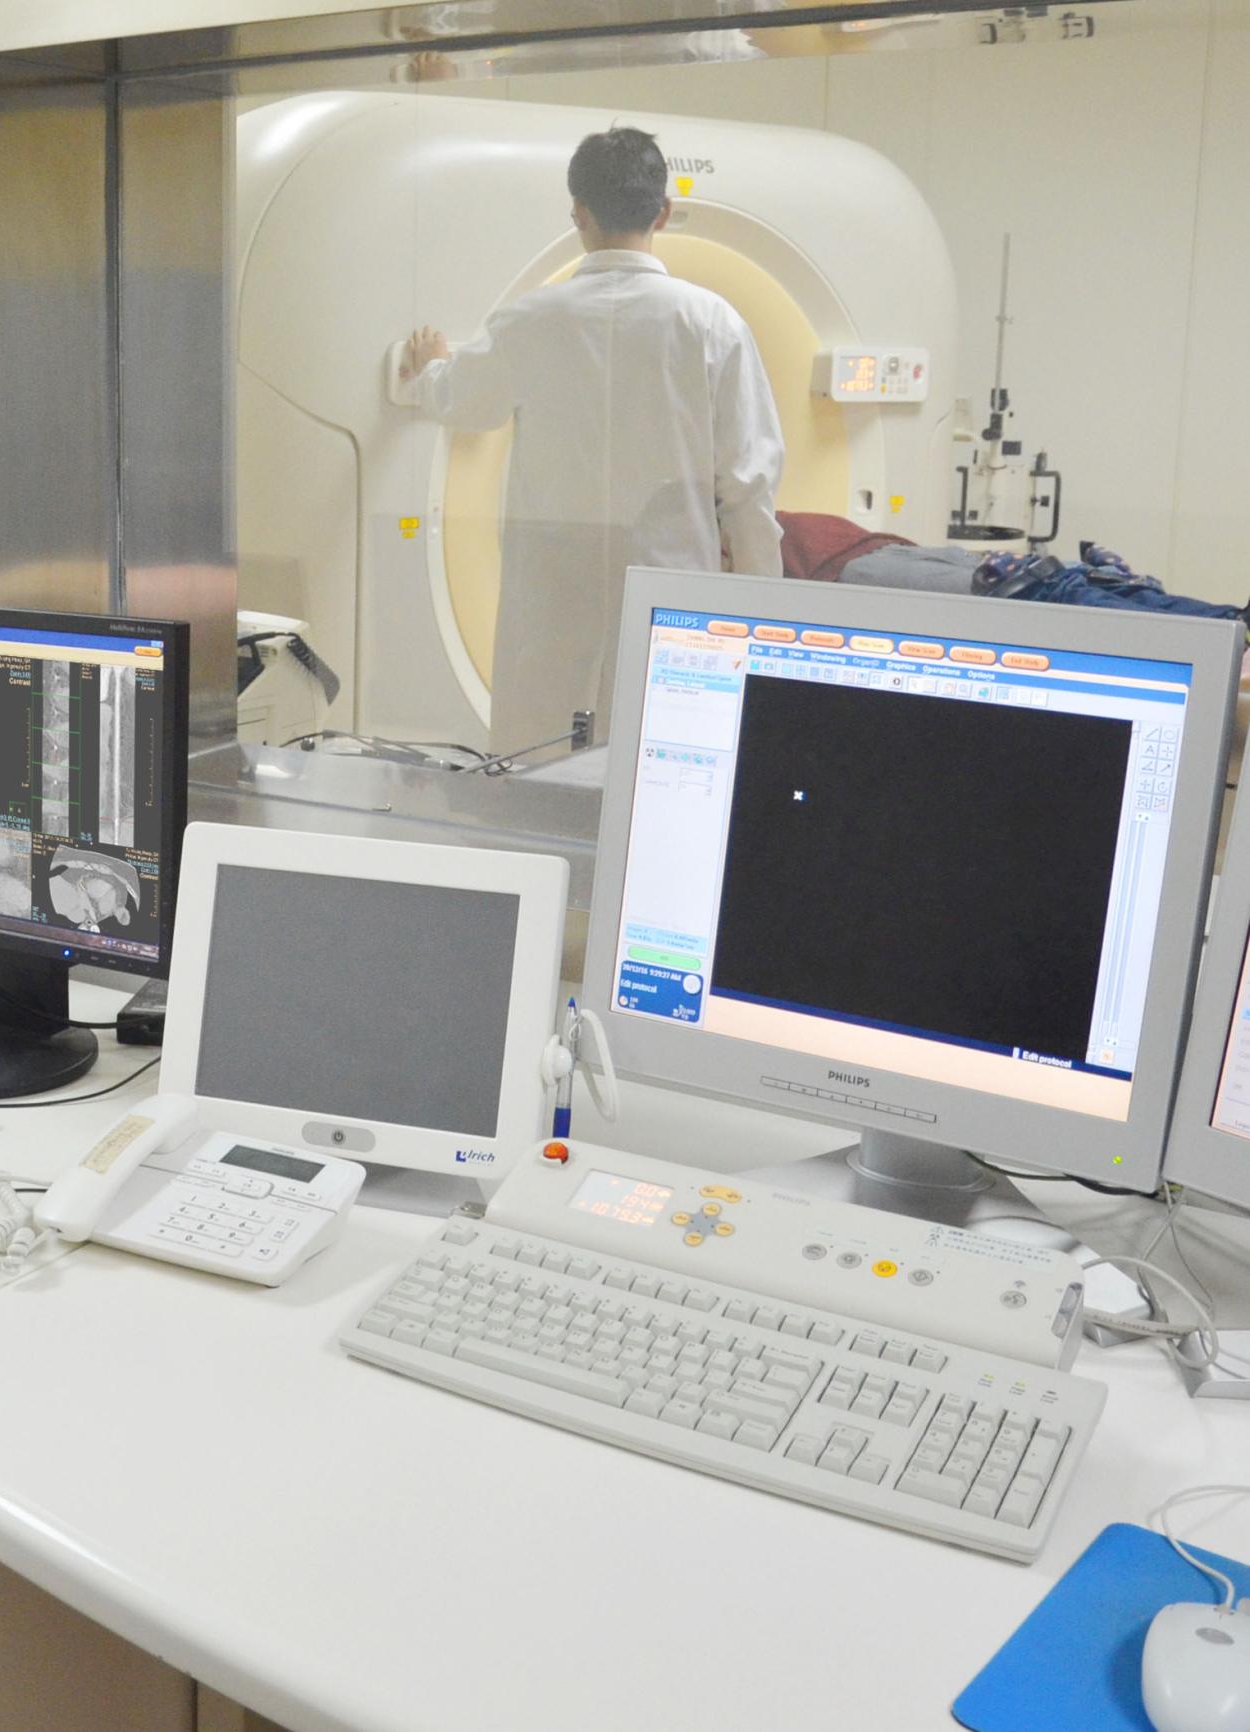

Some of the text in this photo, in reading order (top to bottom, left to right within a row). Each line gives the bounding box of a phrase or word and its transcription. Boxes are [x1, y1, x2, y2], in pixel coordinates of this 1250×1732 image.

[655, 613, 700, 628] PHILIPS
[788, 650, 803, 659] View
[810, 652, 846, 664] Windowing
[886, 661, 916, 672] Graphics
[923, 665, 961, 677] Operations
[968, 670, 996, 681] Options
[1022, 1050, 1072, 1068] Edit protocol
[828, 1070, 871, 1088] PHILIPS
